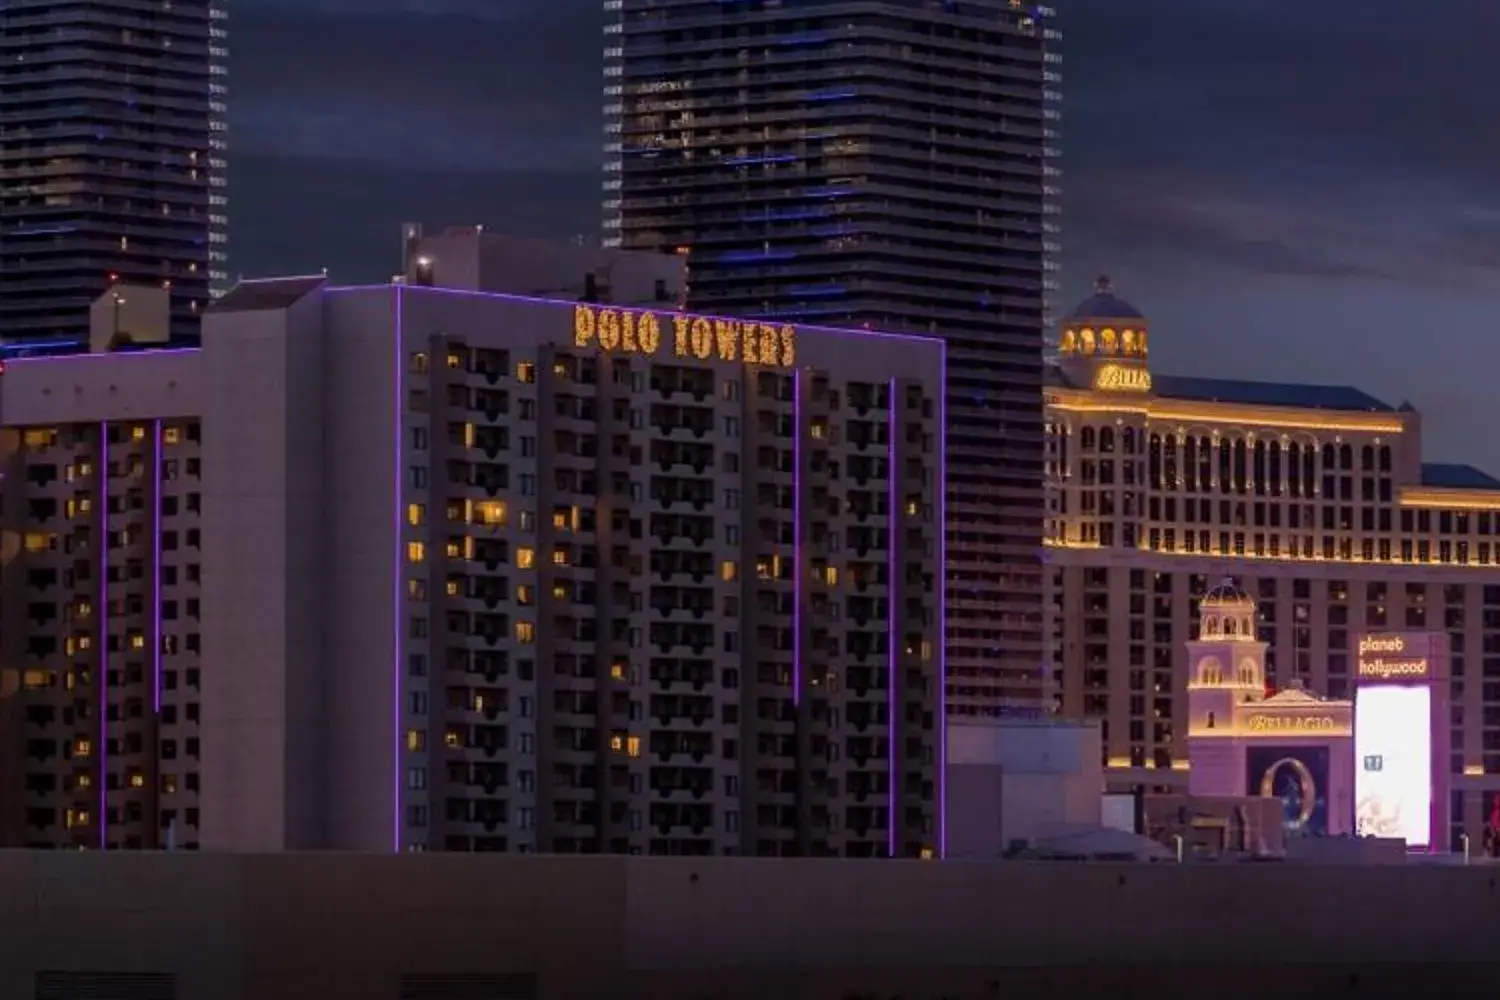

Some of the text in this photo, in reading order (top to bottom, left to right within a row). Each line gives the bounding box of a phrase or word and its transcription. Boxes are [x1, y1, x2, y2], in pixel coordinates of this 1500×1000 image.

[575, 303, 797, 367] POLO TOWERS
[1360, 635, 1404, 656] planet
[1360, 658, 1427, 678] hollywood
